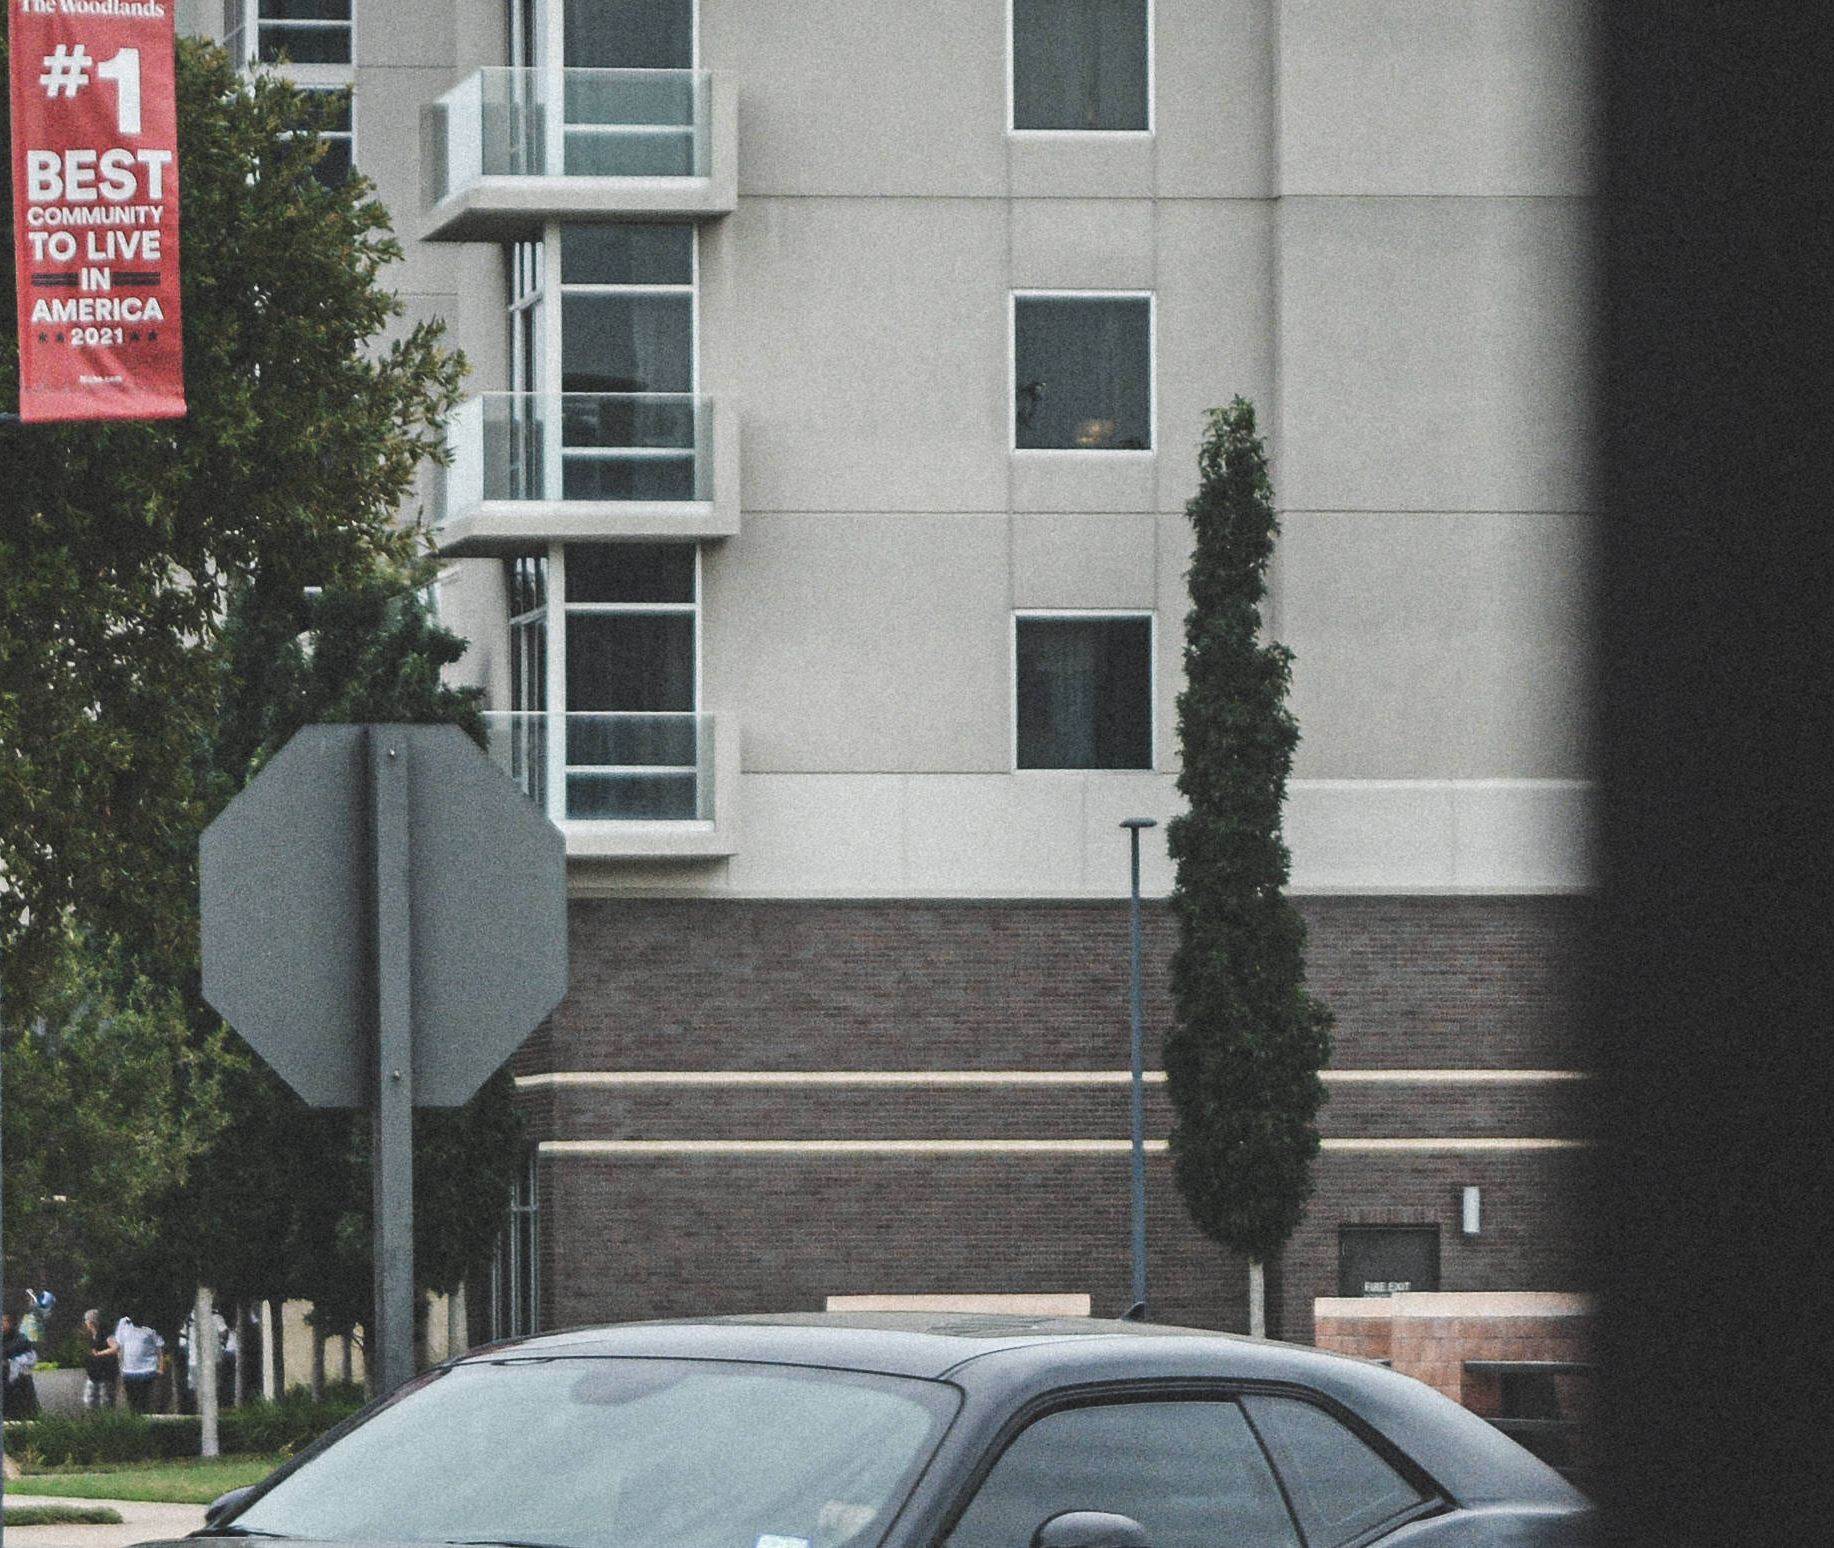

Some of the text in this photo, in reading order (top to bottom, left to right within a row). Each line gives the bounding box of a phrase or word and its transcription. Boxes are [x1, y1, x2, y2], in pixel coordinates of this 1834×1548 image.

[22, 0, 164, 17] The Woodlands
[40, 44, 142, 136] #1
[27, 148, 173, 202] BEST
[27, 206, 164, 227] COMMUNITY
[29, 230, 161, 262] TO LIVE
[81, 267, 111, 291] IN
[31, 297, 164, 322] AMERICA
[71, 327, 125, 346] 2021
